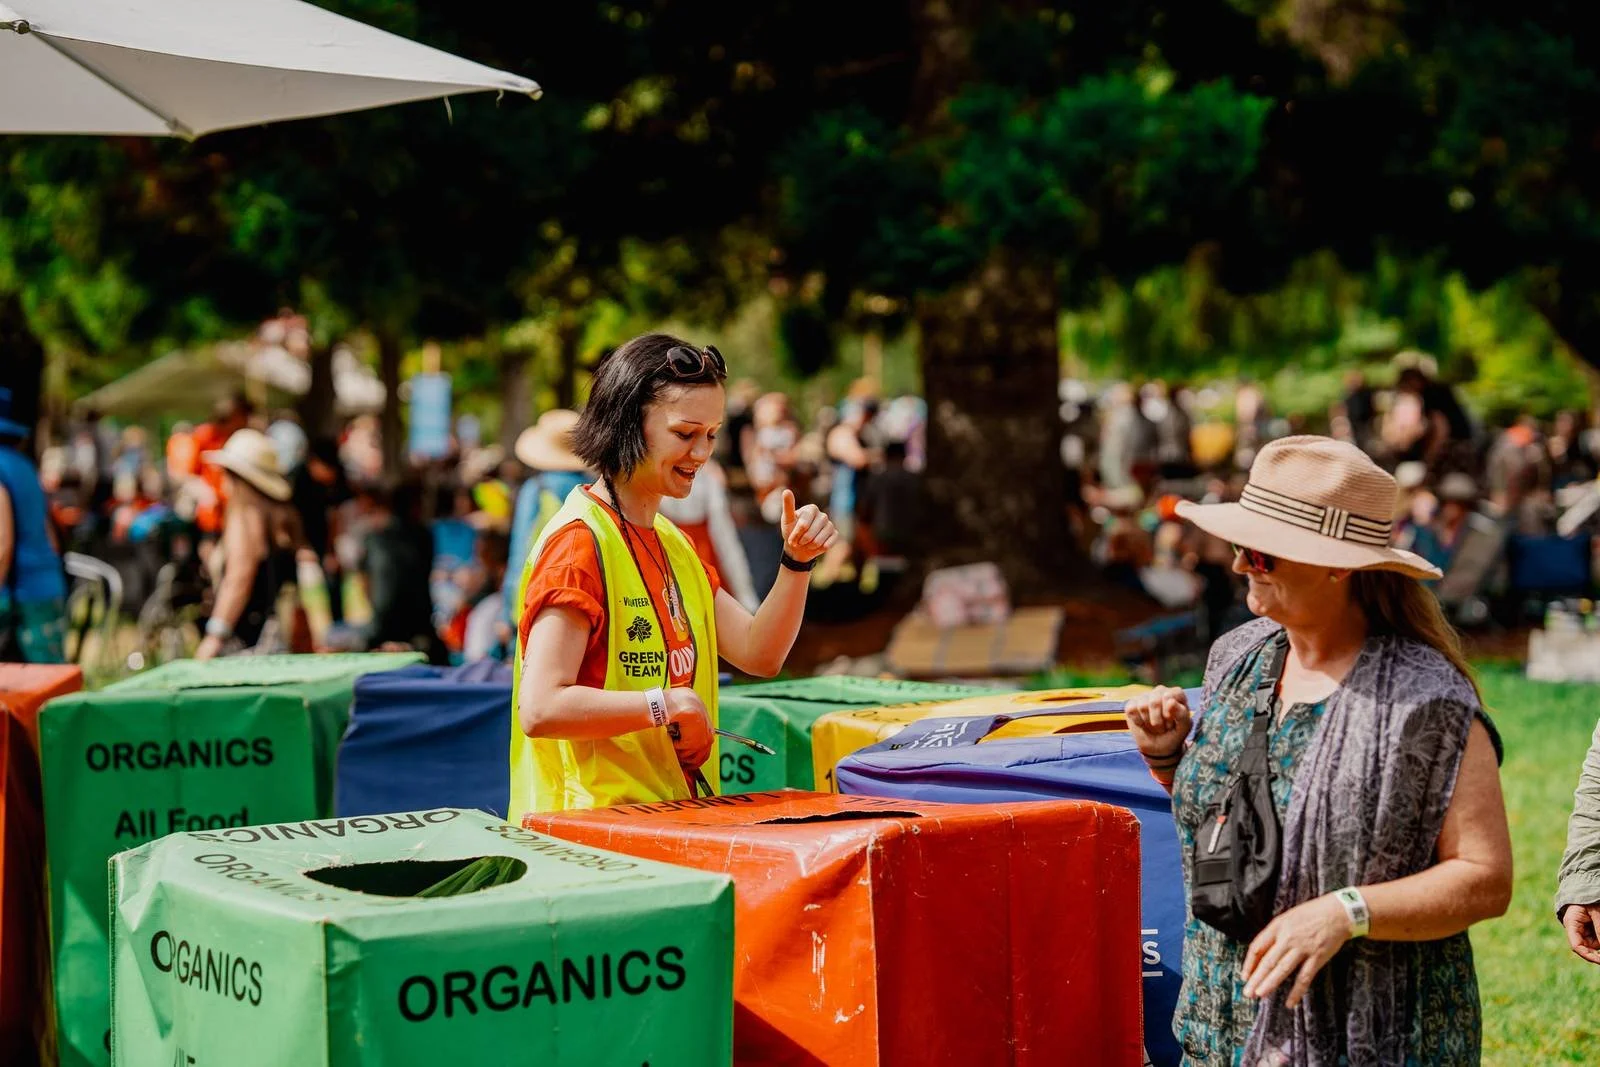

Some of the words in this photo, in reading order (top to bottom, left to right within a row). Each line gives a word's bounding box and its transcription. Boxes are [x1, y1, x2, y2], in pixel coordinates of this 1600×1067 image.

[619, 651, 664, 664] GREEN
[623, 664, 661, 677] TEAM
[86, 737, 274, 772] ORGANICS
[114, 810, 156, 839] All
[168, 807, 250, 835] Food
[397, 945, 687, 1022] ORGANICS
